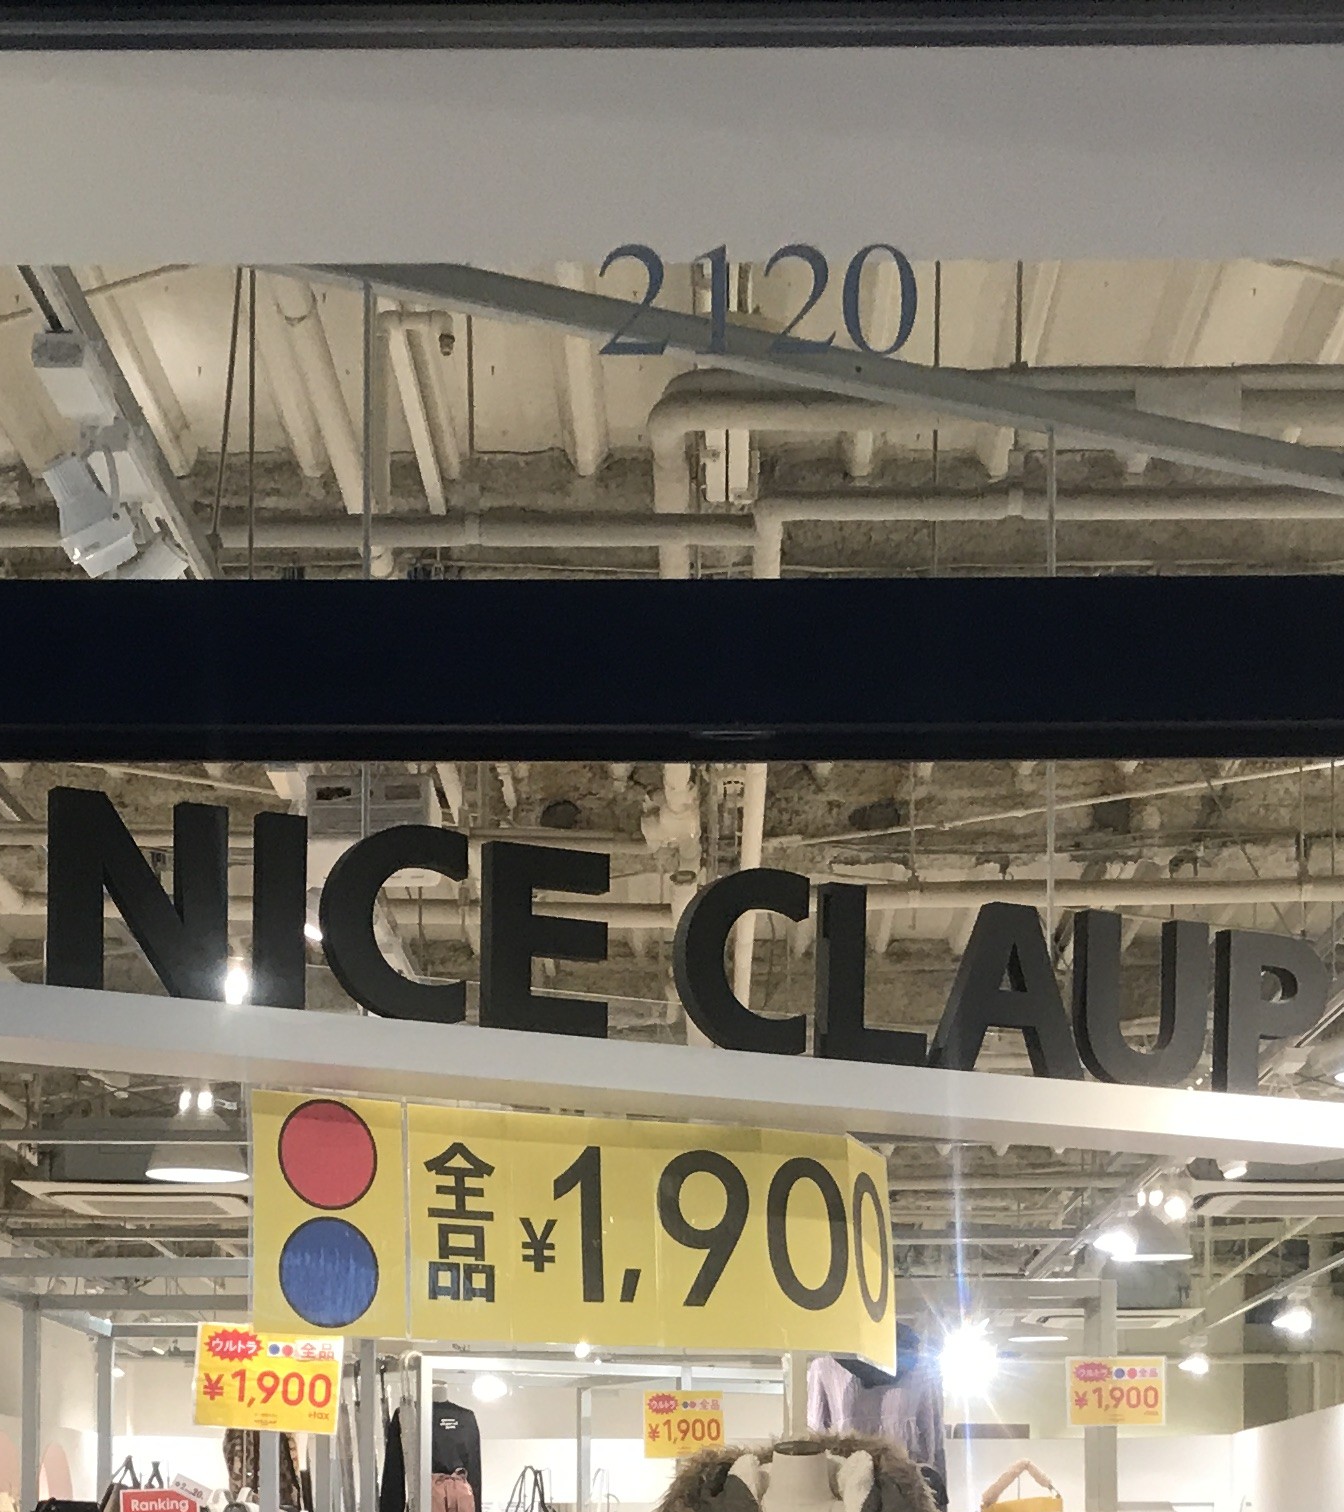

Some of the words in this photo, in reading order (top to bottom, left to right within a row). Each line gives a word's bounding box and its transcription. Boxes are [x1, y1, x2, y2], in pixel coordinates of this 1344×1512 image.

[598, 243, 918, 355] 2120
[47, 785, 610, 1038] NICE
[674, 866, 1333, 1094] CLAUP
[424, 1140, 497, 1305] 全品
[519, 1140, 892, 1324] ¥1,900
[211, 1338, 257, 1355] ウルトラ
[301, 1342, 335, 1361] 全品
[203, 1368, 332, 1409] ¥1,900
[1074, 1385, 1159, 1412] ¥1,900
[648, 1418, 721, 1444] ¥1,900
[131, 1498, 189, 1512] Ranking
